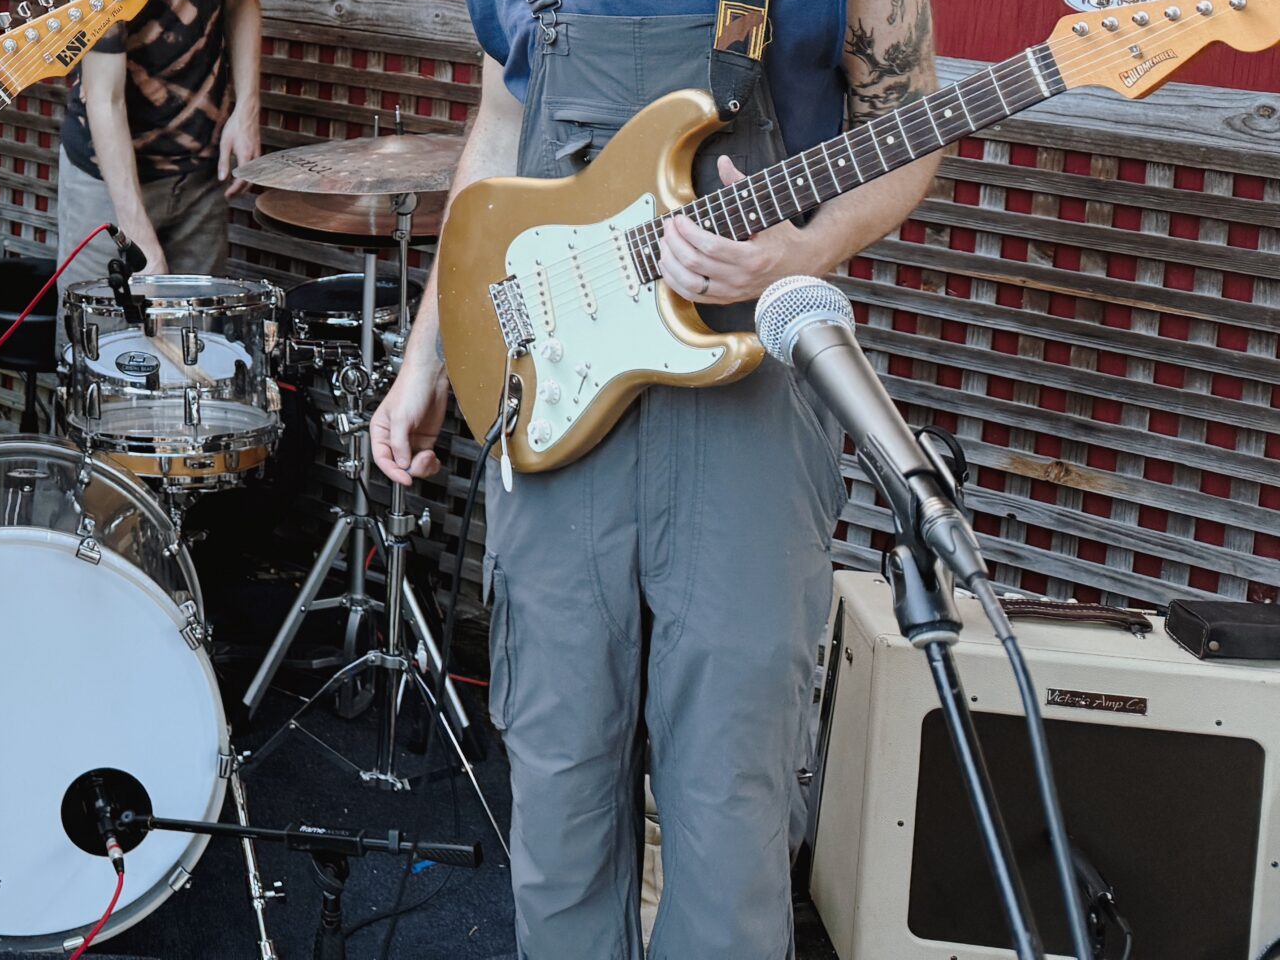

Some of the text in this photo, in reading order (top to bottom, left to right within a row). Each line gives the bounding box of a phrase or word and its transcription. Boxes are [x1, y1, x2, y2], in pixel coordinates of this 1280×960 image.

[1119, 49, 1178, 88] GOLDMEMBER
[1047, 690, 1091, 705] Victoria
[1092, 695, 1124, 711] Amp
